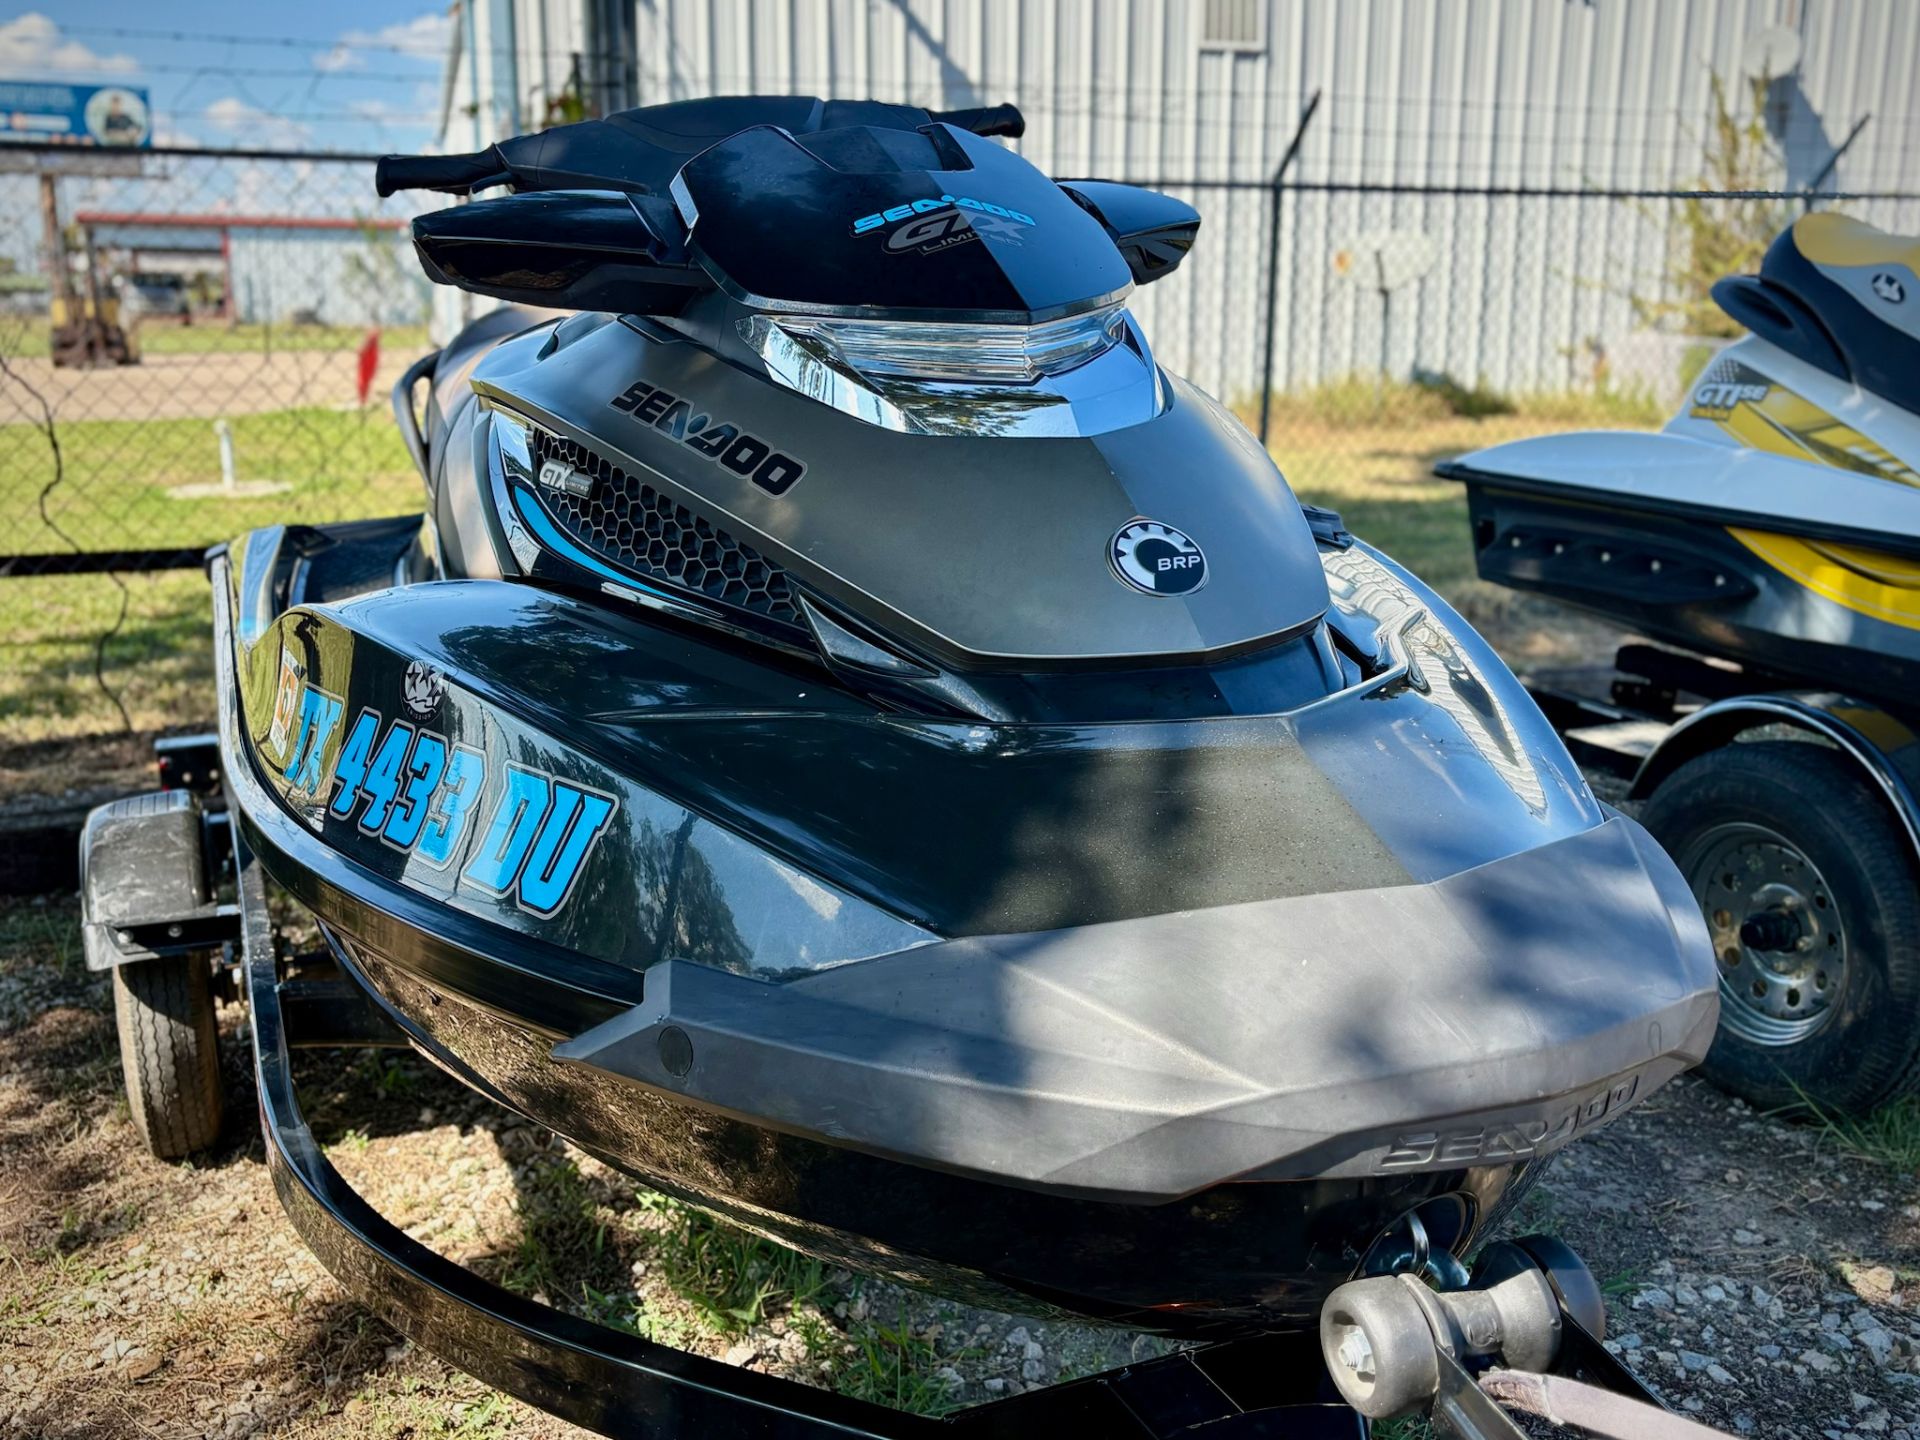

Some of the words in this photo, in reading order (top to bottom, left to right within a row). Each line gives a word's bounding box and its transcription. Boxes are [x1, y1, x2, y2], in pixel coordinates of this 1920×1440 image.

[887, 207, 1028, 250] GTX
[1695, 383, 1743, 407] GTI
[540, 461, 573, 490] GTX
[1157, 555, 1201, 571] BRP
[283, 686, 343, 796] TX
[332, 709, 486, 868] 4433
[464, 764, 617, 916] DU
